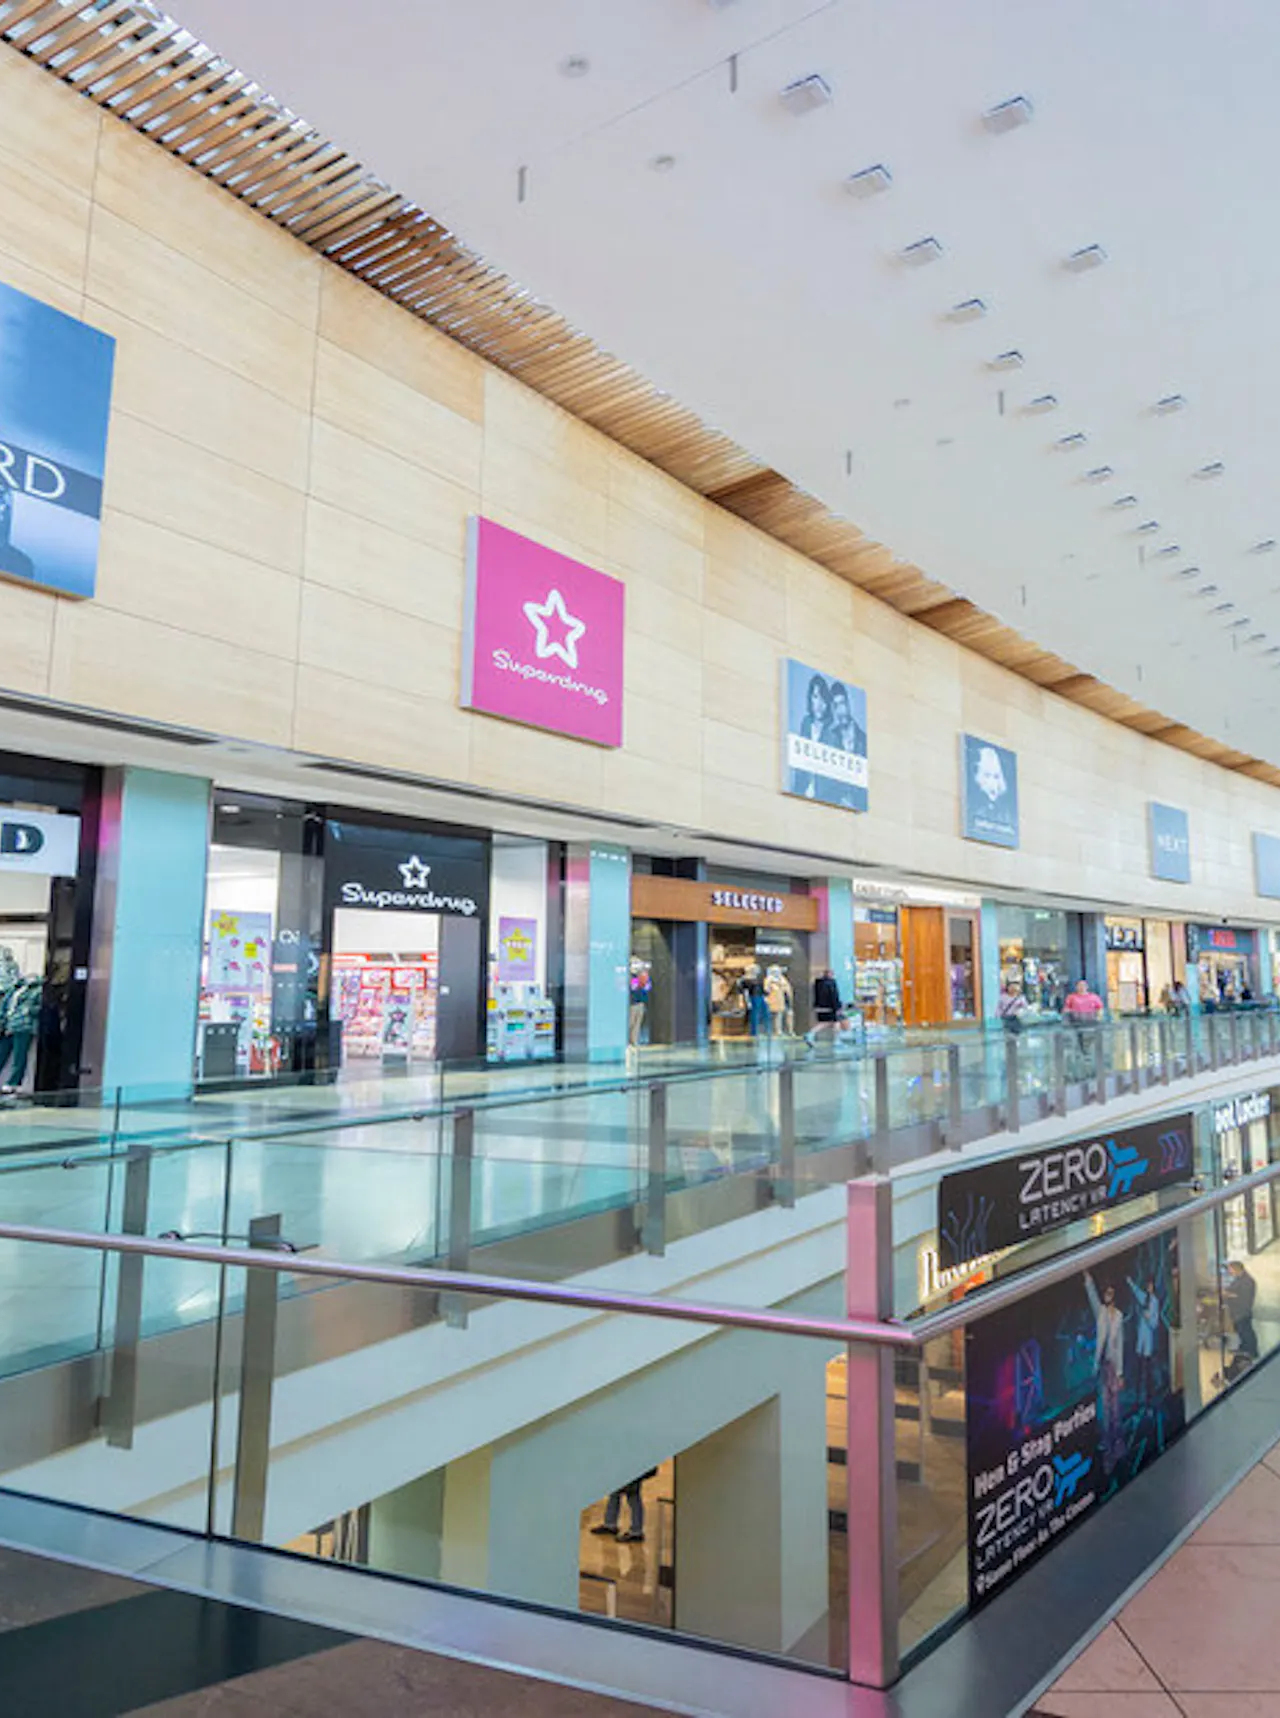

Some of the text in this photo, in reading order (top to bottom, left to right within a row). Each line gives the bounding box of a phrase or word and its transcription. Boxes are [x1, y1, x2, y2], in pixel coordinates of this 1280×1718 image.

[492, 648, 608, 705] Superdrug
[793, 738, 863, 775] SELECTED
[341, 882, 478, 915] Superdrug
[712, 890, 784, 913] SELECTED
[1019, 1142, 1108, 1204] ZERO
[1019, 1191, 1089, 1230] LATENCY
[976, 1464, 1054, 1548] ZERO
